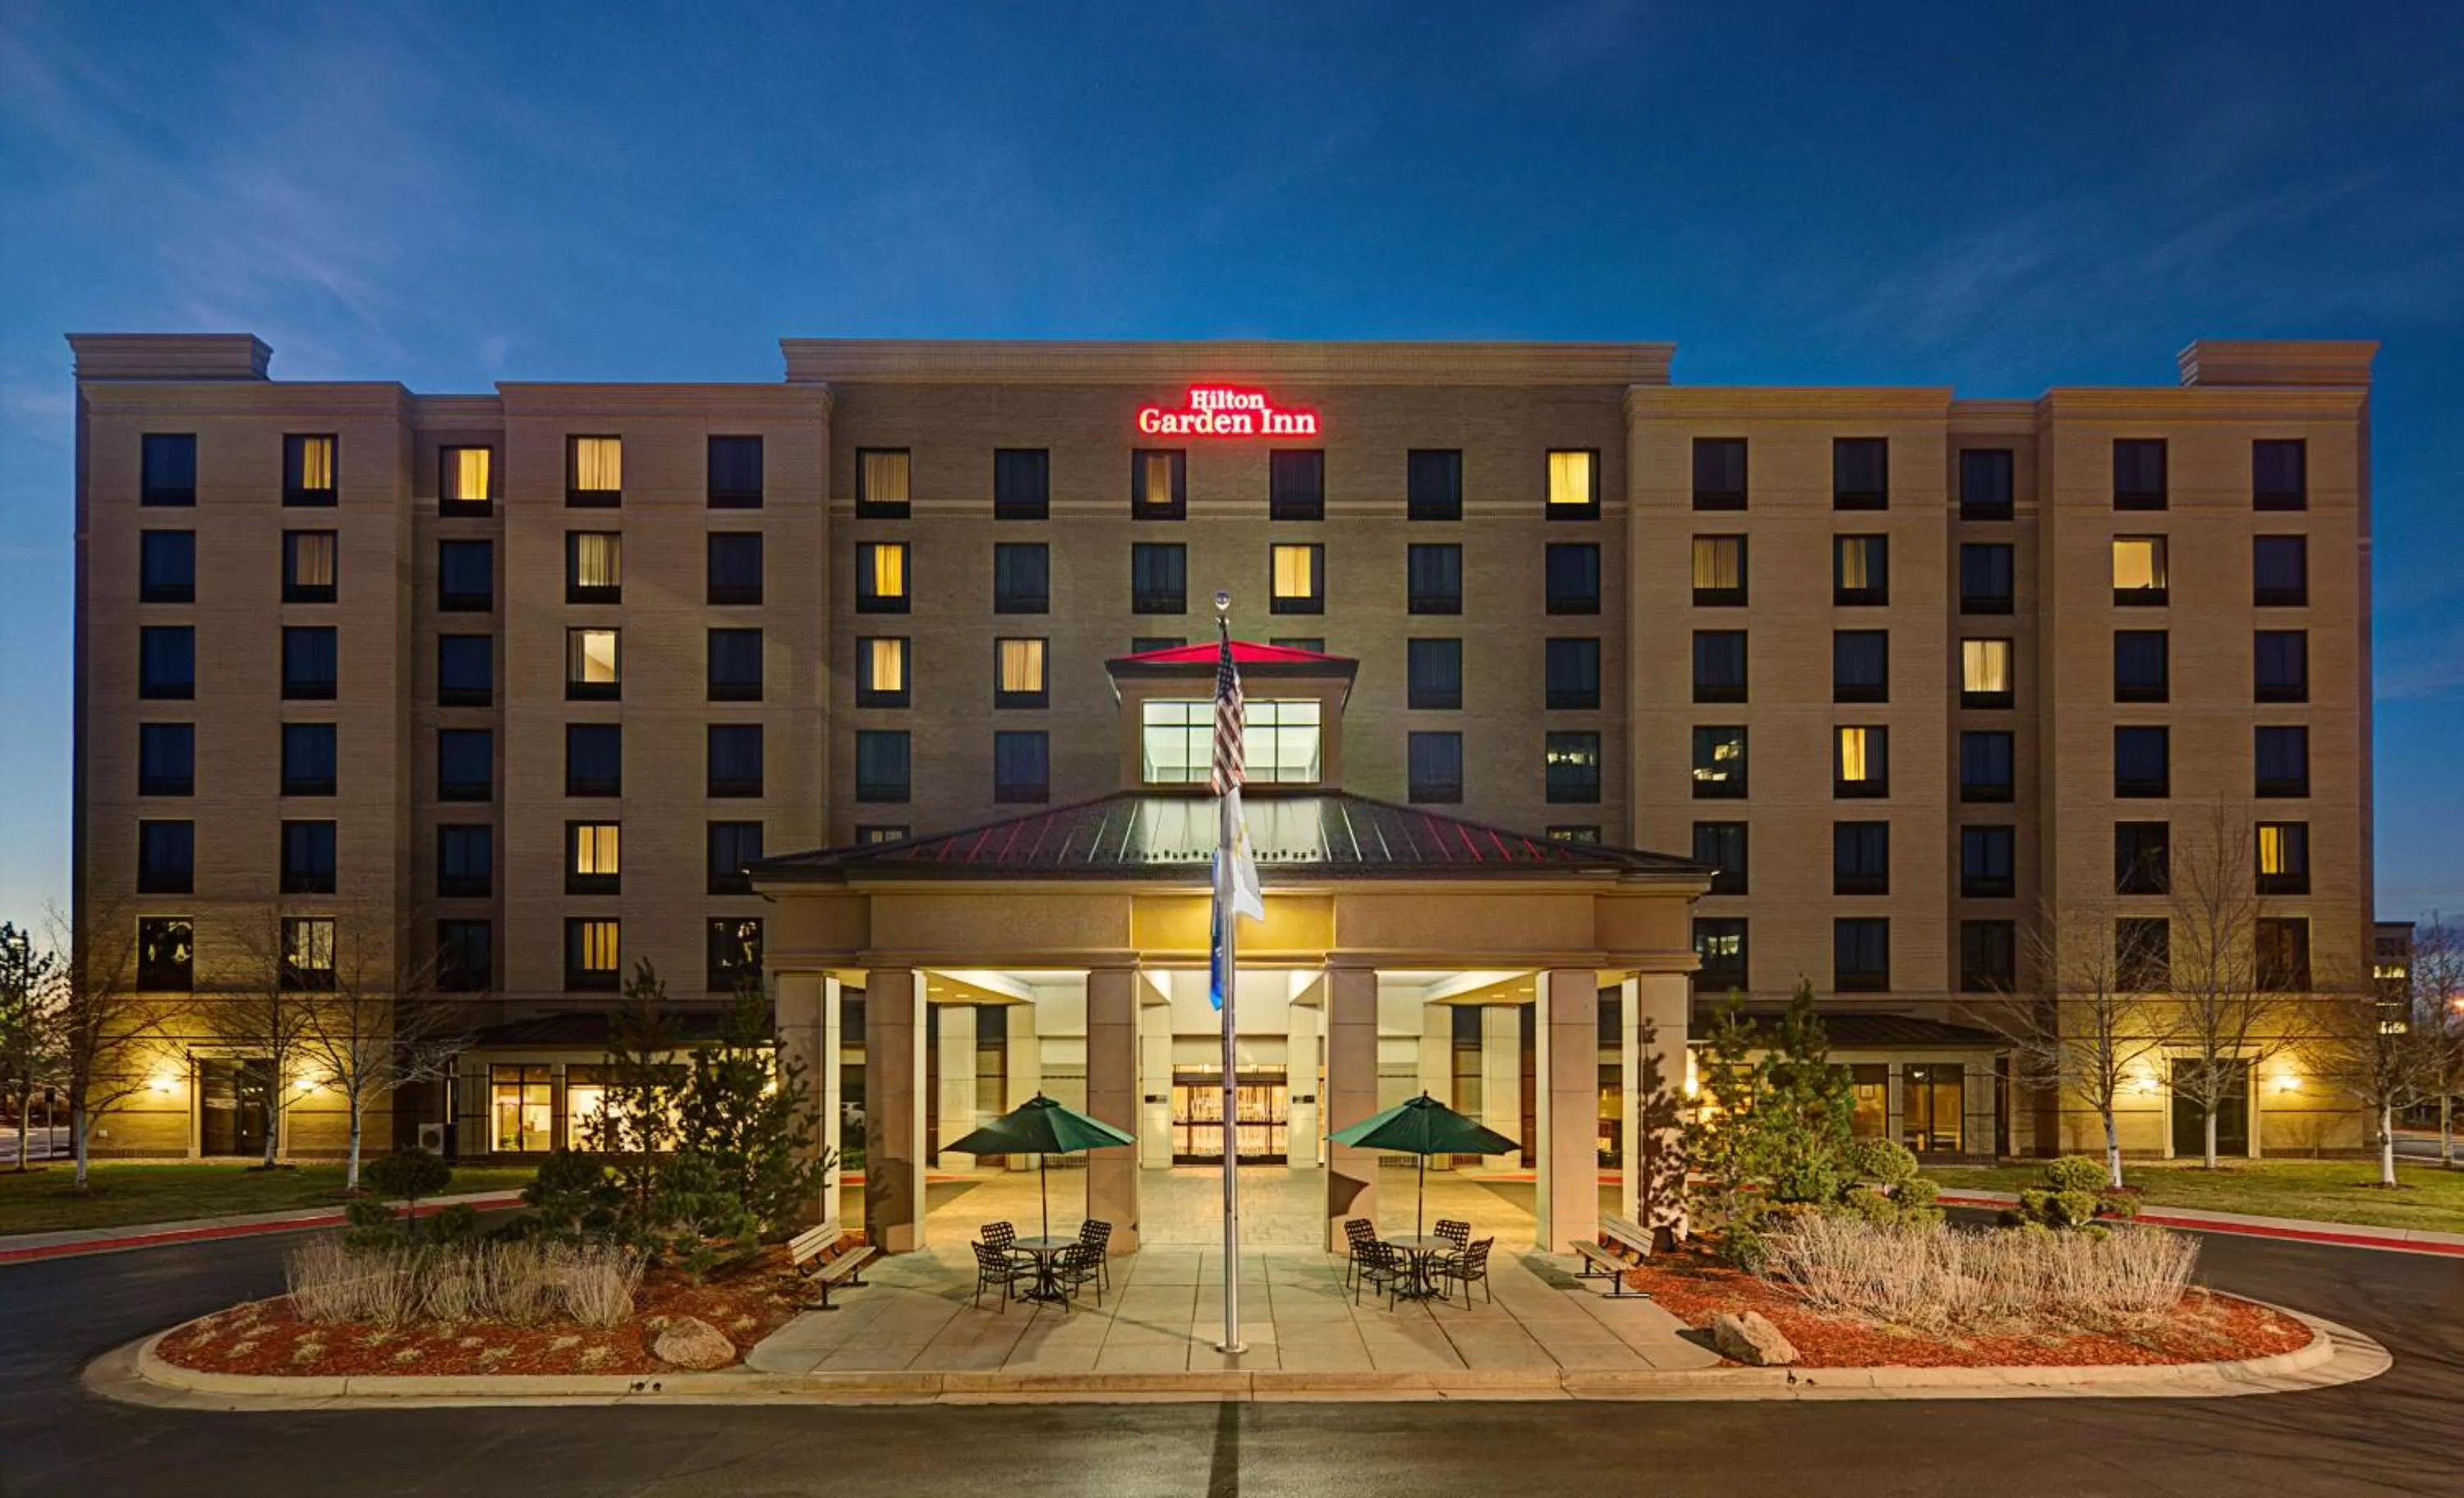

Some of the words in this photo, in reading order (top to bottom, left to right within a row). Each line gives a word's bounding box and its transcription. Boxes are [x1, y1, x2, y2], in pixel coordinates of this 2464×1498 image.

[1190, 389, 1265, 410] Hilton
[1139, 408, 1254, 434] Garden
[1261, 408, 1317, 434] Inn
